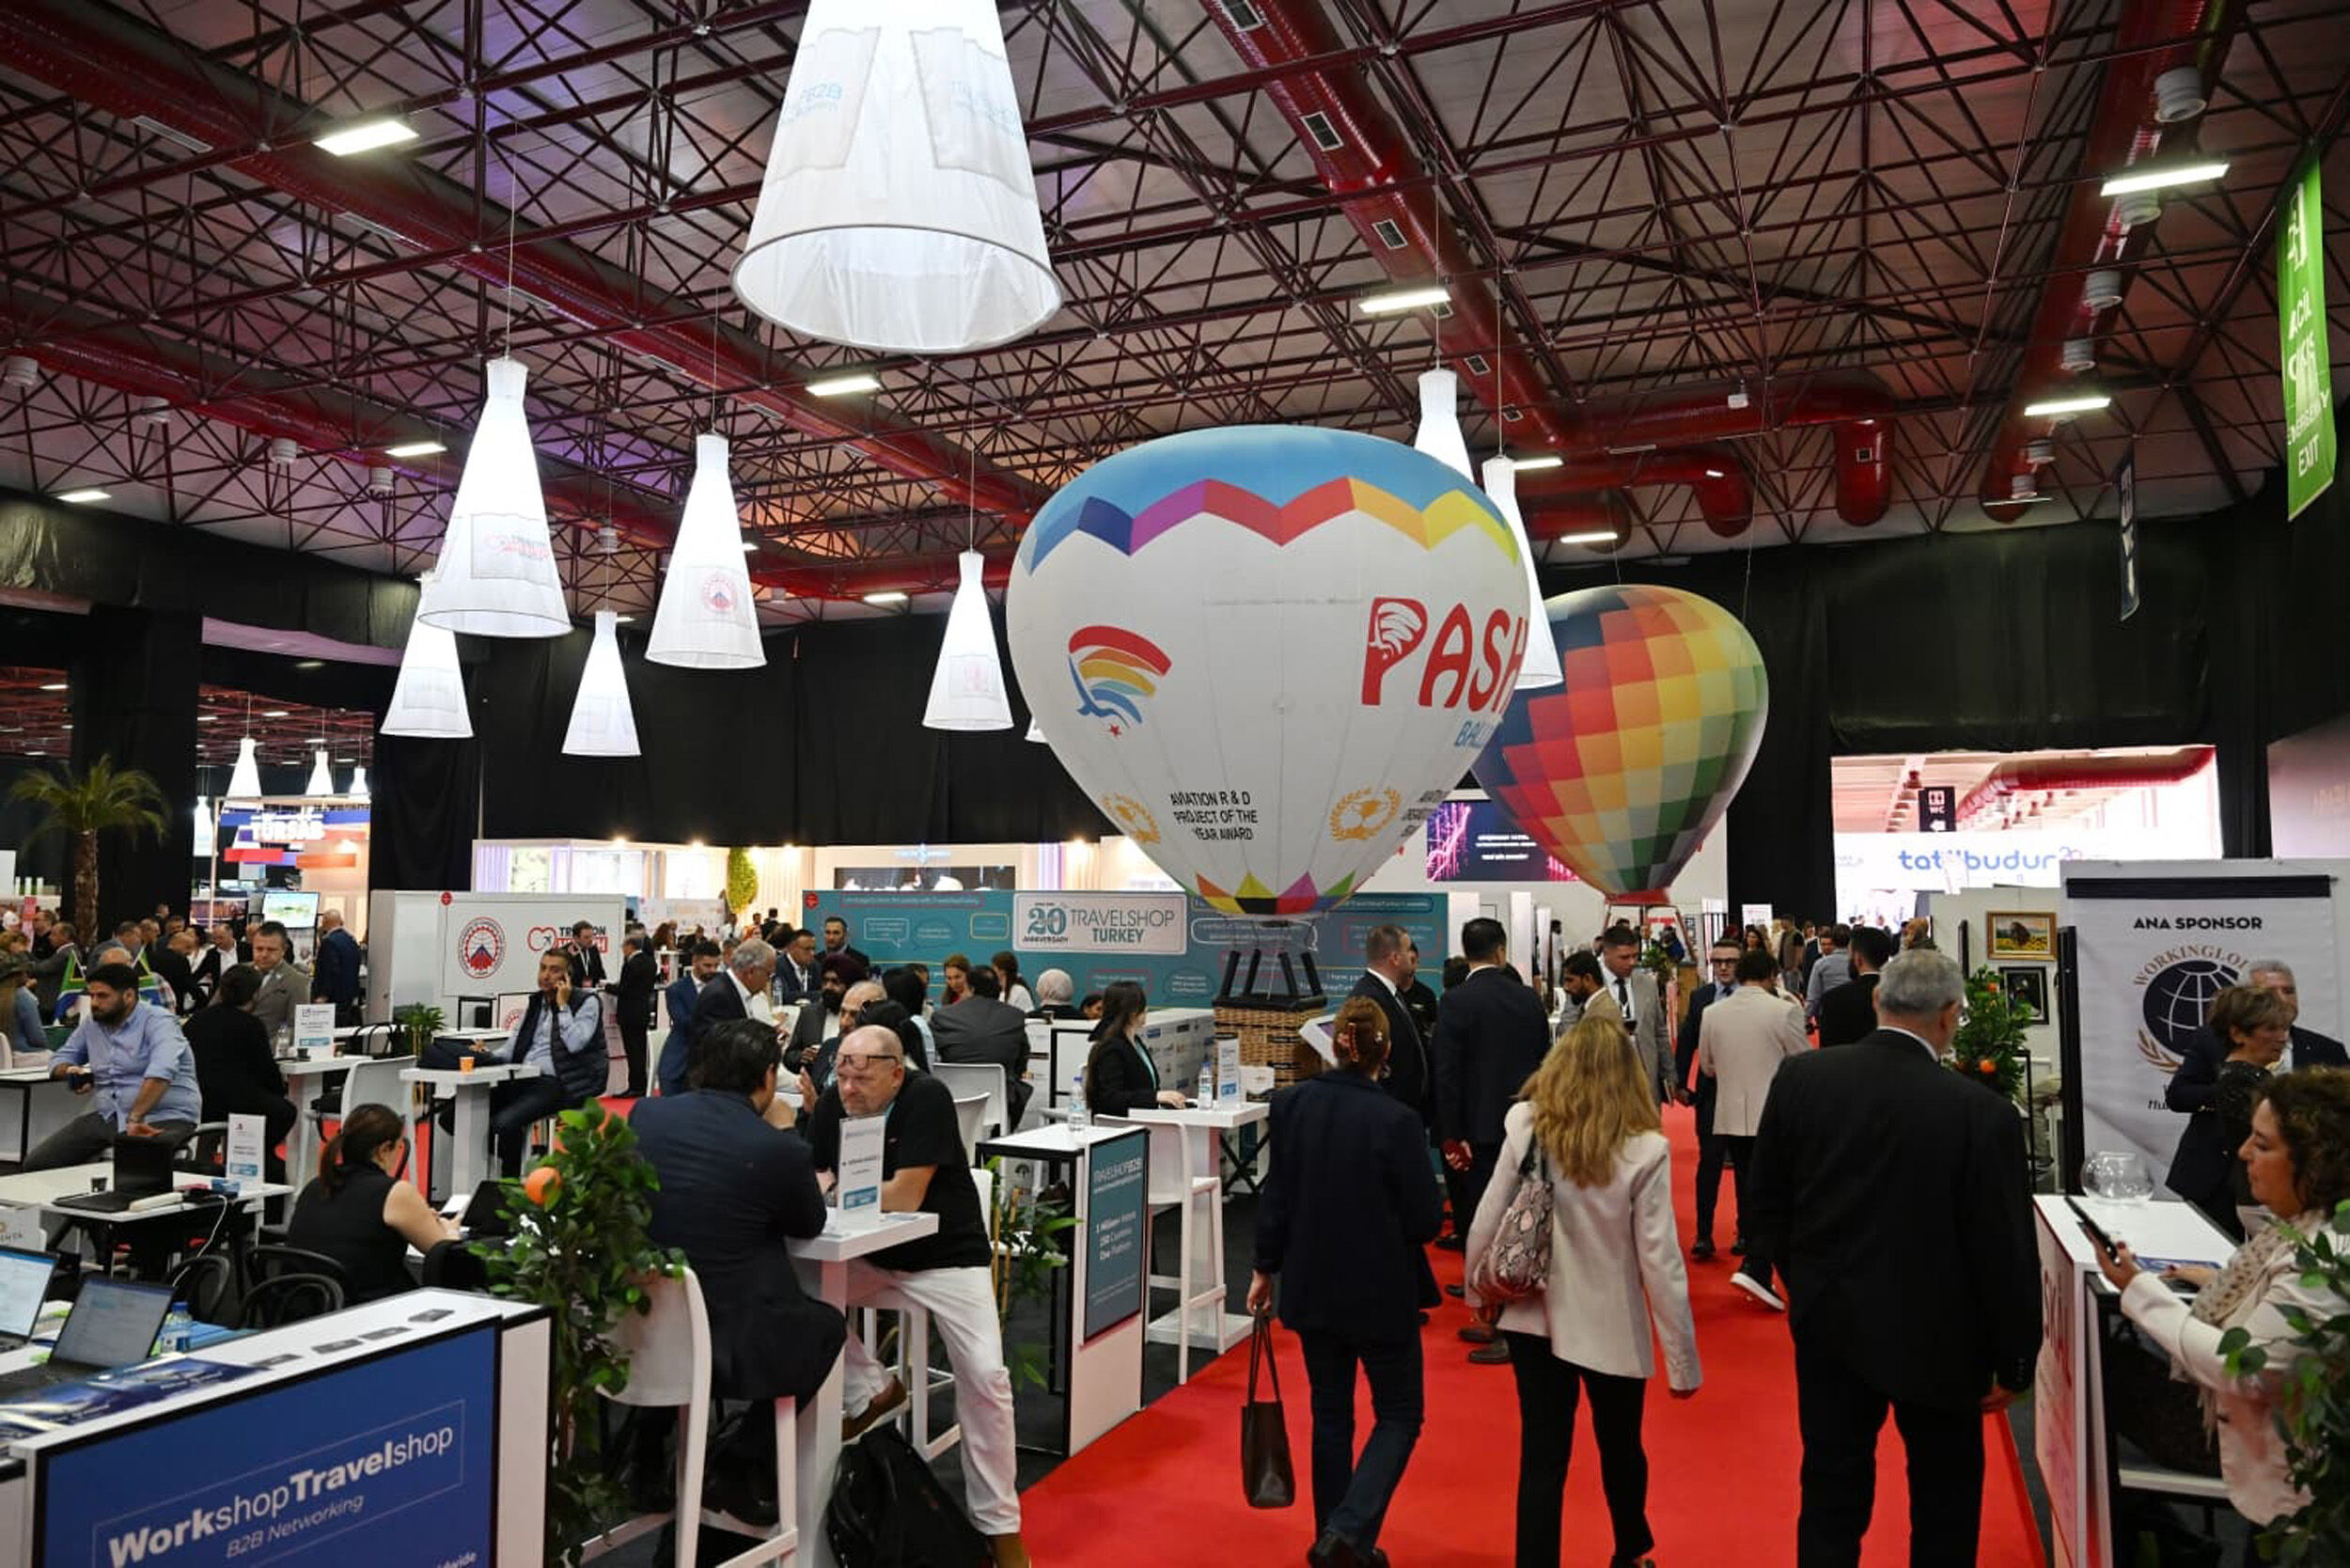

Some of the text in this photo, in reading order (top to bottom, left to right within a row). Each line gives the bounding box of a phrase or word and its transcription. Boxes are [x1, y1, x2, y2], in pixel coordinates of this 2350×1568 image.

[2298, 433, 2319, 477] EXIT
[1219, 792, 1229, 805] R
[1230, 791, 1239, 805] &
[1242, 792, 1250, 805] D
[1173, 809, 1258, 824] PROJECT OF THE
[1898, 849, 2057, 870] tatbudur
[1027, 906, 1175, 935] 20 TRAVELSHOP
[2134, 917, 2263, 930] ANA SPONSOR
[1092, 928, 1145, 943] TURKEY
[227, 1495, 365, 1559] B2B Networking
